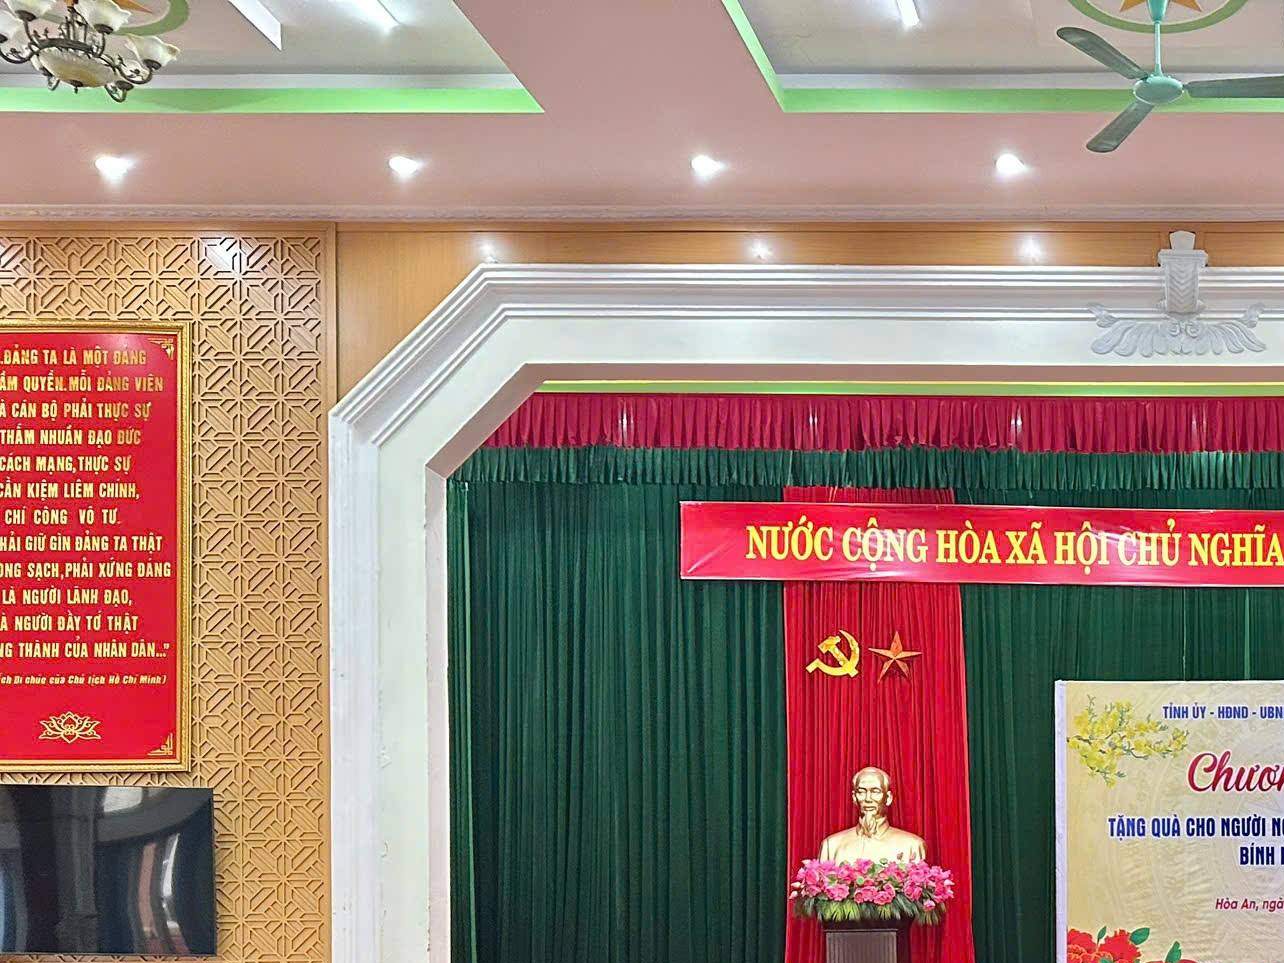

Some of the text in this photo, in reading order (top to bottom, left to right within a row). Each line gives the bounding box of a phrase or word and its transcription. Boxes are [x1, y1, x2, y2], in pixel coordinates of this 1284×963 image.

[42, 343, 147, 368] TA LÀ MỘT ĐẢNG
[97, 371, 163, 391] ĐẢNG VIÊN
[12, 398, 151, 421] CÁN BỘ PHẢI THỰC SỰ
[88, 426, 141, 448] ĐẠO ĐỨC
[0, 453, 131, 474] CÁCH SỰ
[27, 479, 139, 501] KIỆM LIÊM CHÍNH,
[5, 506, 27, 524] CHÍ
[34, 506, 68, 525] CÔNG
[79, 506, 95, 524] VÔ
[25, 530, 162, 554] GIỮ GÌN ĐẢNG TA THẬT
[746, 515, 834, 560] NƯỚC
[843, 517, 927, 571] CỘNG
[936, 520, 1001, 564] HÒA
[1006, 522, 1047, 565] XÃ
[1054, 520, 1109, 575] HỘI
[1118, 518, 1180, 566] CHỦ
[99, 557, 171, 577] XỨNG ĐÁNG
[2, 585, 132, 607] LÀ NGƯỜI LÃNH ĐẠO,
[15, 613, 52, 631] NGƯỜI
[86, 610, 102, 631] TỚ
[107, 613, 138, 634] THẬT
[19, 636, 127, 658] THÀNH CỦA NHÂN
[1162, 702, 1188, 719] TỈNH
[1192, 701, 1206, 719] ỦY
[1218, 706, 1248, 719] HĐND
[1108, 815, 1146, 841] TẶNG
[1152, 814, 1180, 838] QUÀ
[1186, 818, 1215, 837] CHO
[1221, 814, 1265, 837] NGƯỜI
[1240, 843, 1275, 865] BÍNH
[1215, 897, 1237, 909] Hòa
[1241, 898, 1259, 911] An,
